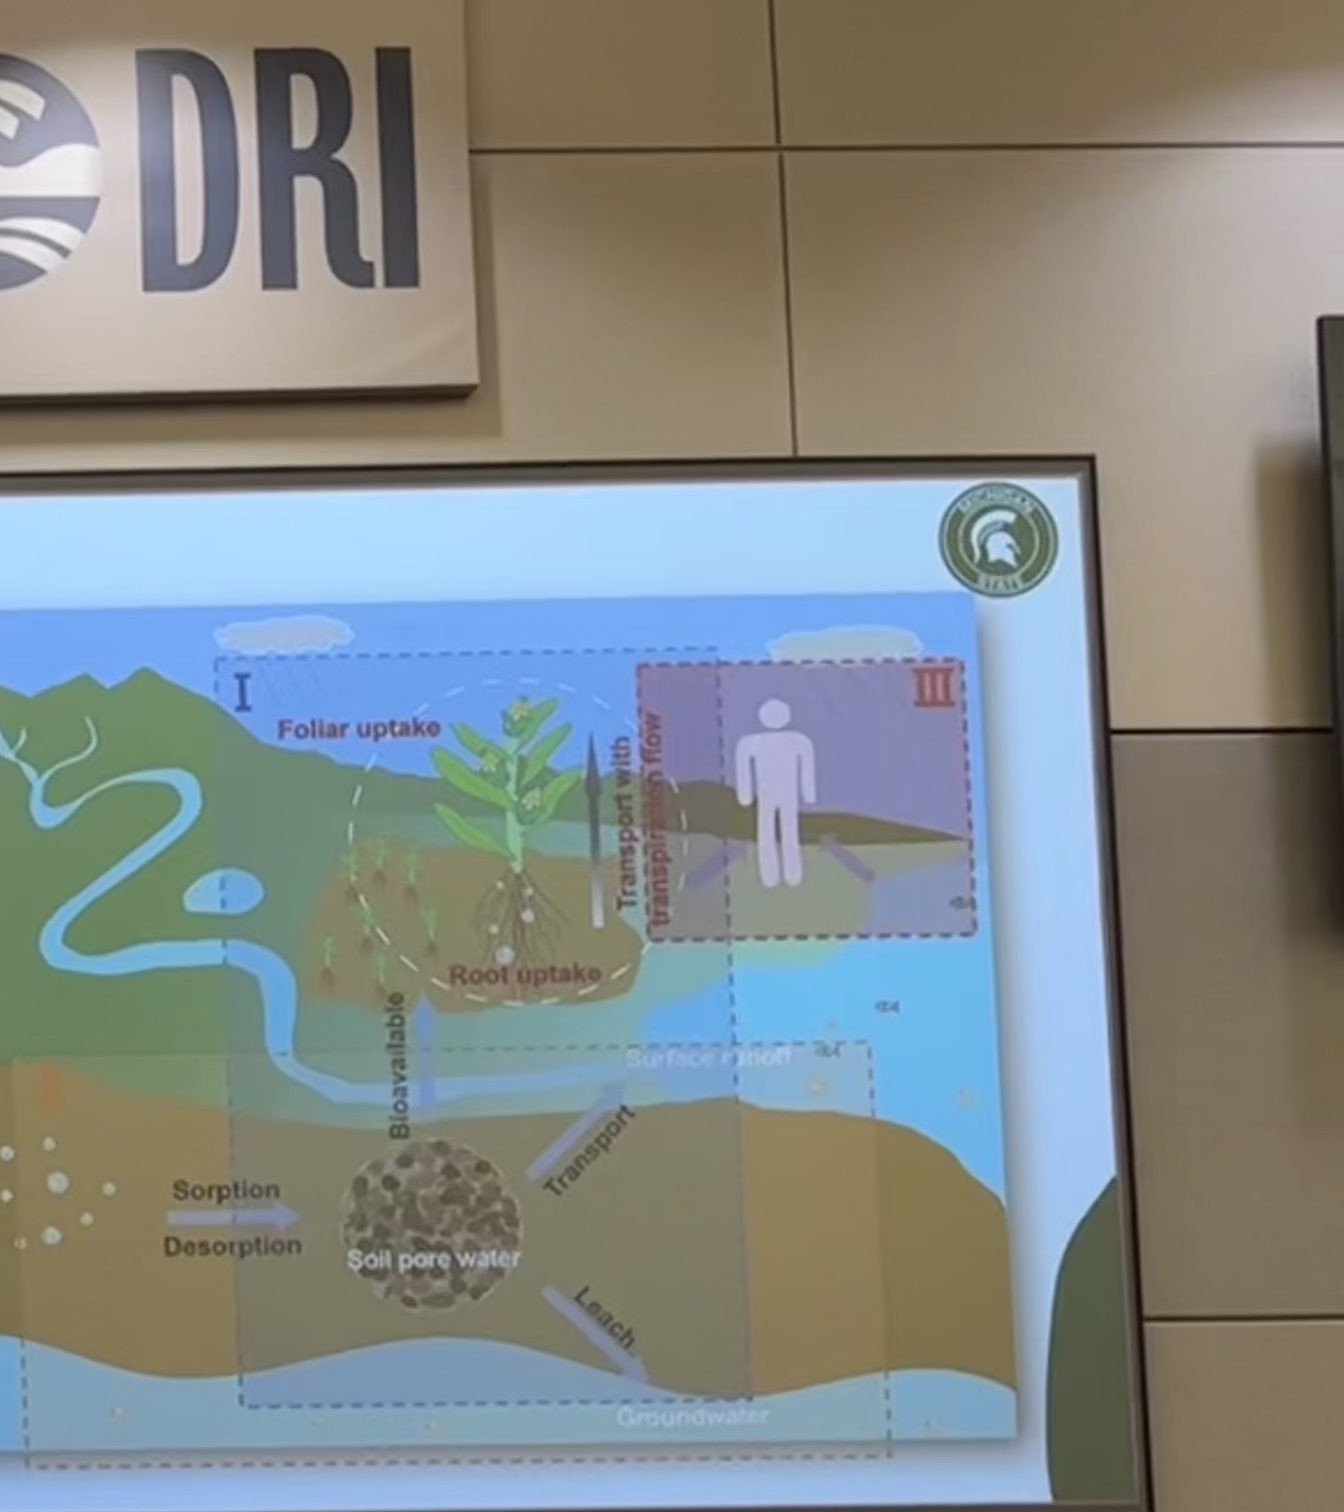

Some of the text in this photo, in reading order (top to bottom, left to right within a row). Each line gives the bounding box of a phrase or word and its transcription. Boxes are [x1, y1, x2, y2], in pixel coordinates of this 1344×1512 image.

[135, 47, 420, 292] DRI
[277, 717, 442, 742] Foliar uptake
[609, 736, 639, 911] Transport with
[448, 963, 602, 990] Root uptake
[389, 992, 411, 1141] Bioavailable
[542, 1104, 637, 1197] Transport
[172, 1179, 281, 1207] Sorption
[163, 1235, 303, 1260] Desorption
[346, 1247, 523, 1275] Soil pore water
[573, 1285, 637, 1350] Leach
[615, 1405, 771, 1428] Groundwater
